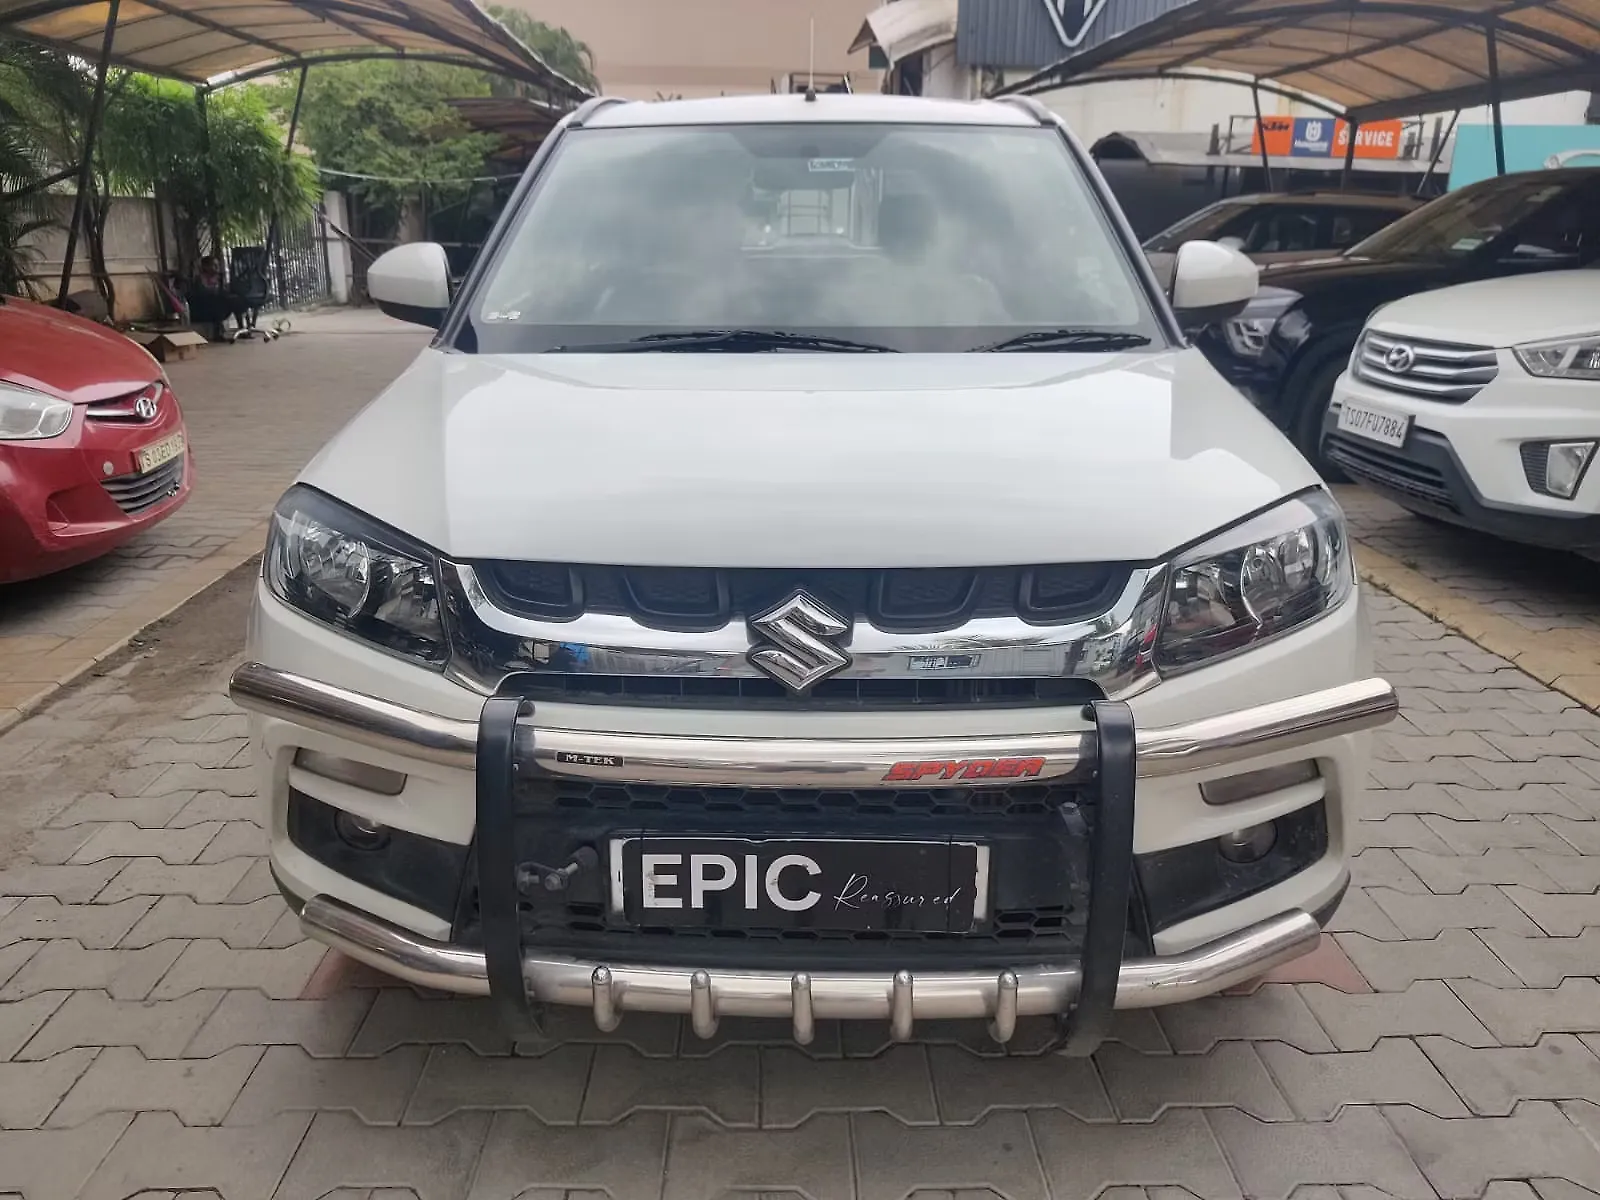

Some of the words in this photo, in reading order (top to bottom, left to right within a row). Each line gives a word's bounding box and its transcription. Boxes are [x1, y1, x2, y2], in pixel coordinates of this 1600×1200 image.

[1337, 129, 1394, 147] SRVICE
[565, 753, 615, 765] M-TEK
[881, 757, 1048, 781] SPYDER
[641, 854, 822, 911] EPIC
